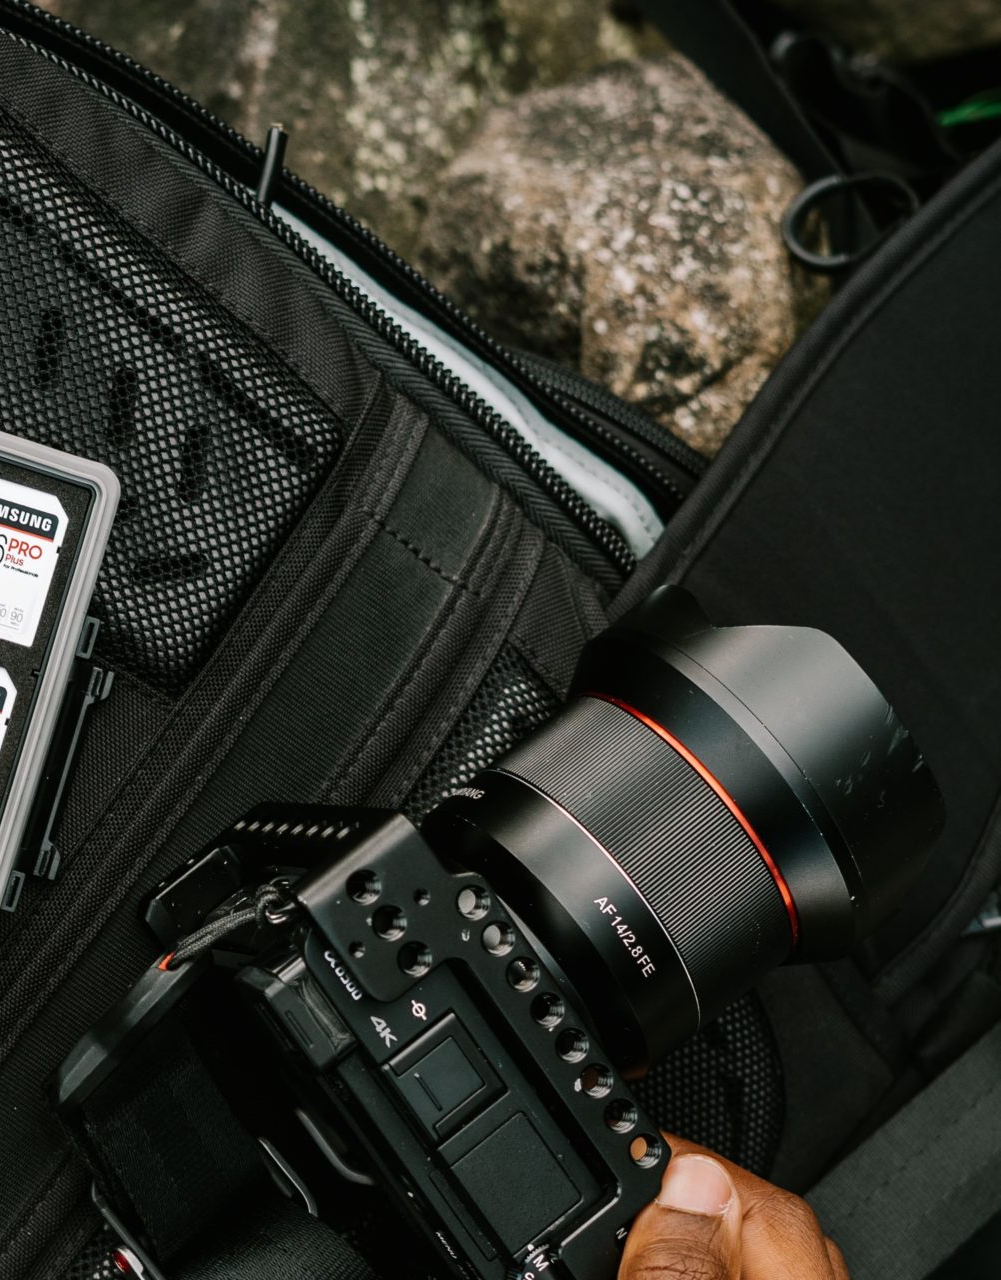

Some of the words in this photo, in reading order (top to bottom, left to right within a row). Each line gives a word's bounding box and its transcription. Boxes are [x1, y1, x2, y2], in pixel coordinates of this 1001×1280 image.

[8, 538, 43, 560] PRO
[5, 553, 24, 566] Plus
[11, 612, 23, 622] 90
[594, 897, 617, 914] AF
[611, 916, 643, 957] 14/2.8
[637, 955, 655, 978] FE
[370, 1016, 398, 1048] 4K
[533, 1254, 549, 1271] M
